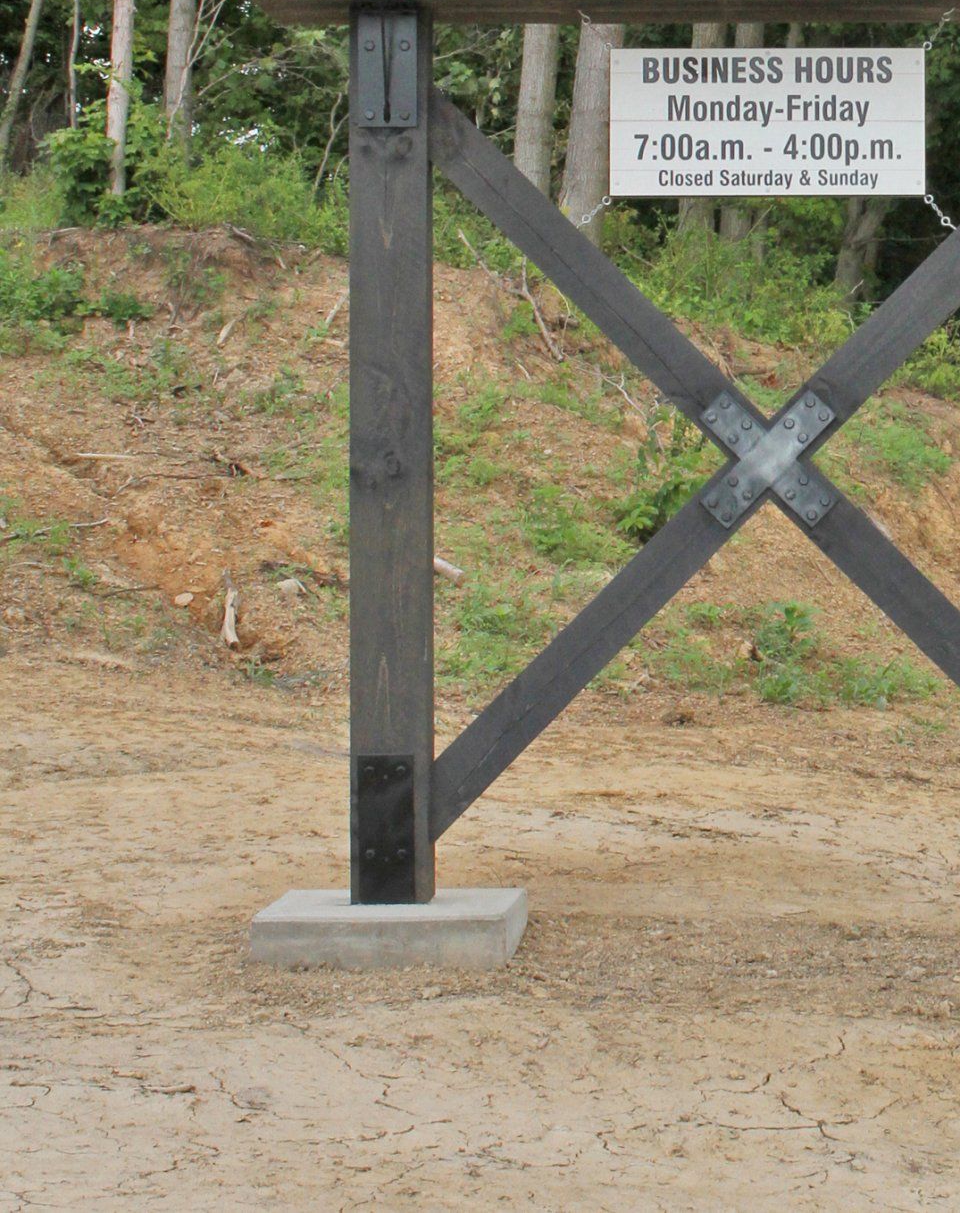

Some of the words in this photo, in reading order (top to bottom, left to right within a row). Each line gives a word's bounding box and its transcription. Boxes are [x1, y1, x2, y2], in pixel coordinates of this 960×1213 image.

[642, 56, 784, 84] BUSINESS
[794, 56, 893, 84] HOURS
[666, 94, 870, 127] Monday-Friday
[633, 133, 753, 161] 7:00a.m.
[782, 133, 903, 166] 4:00p.m.
[658, 170, 714, 187] Closed
[719, 170, 793, 190] Saturday
[799, 170, 812, 186] &
[817, 170, 879, 190] Sunday
